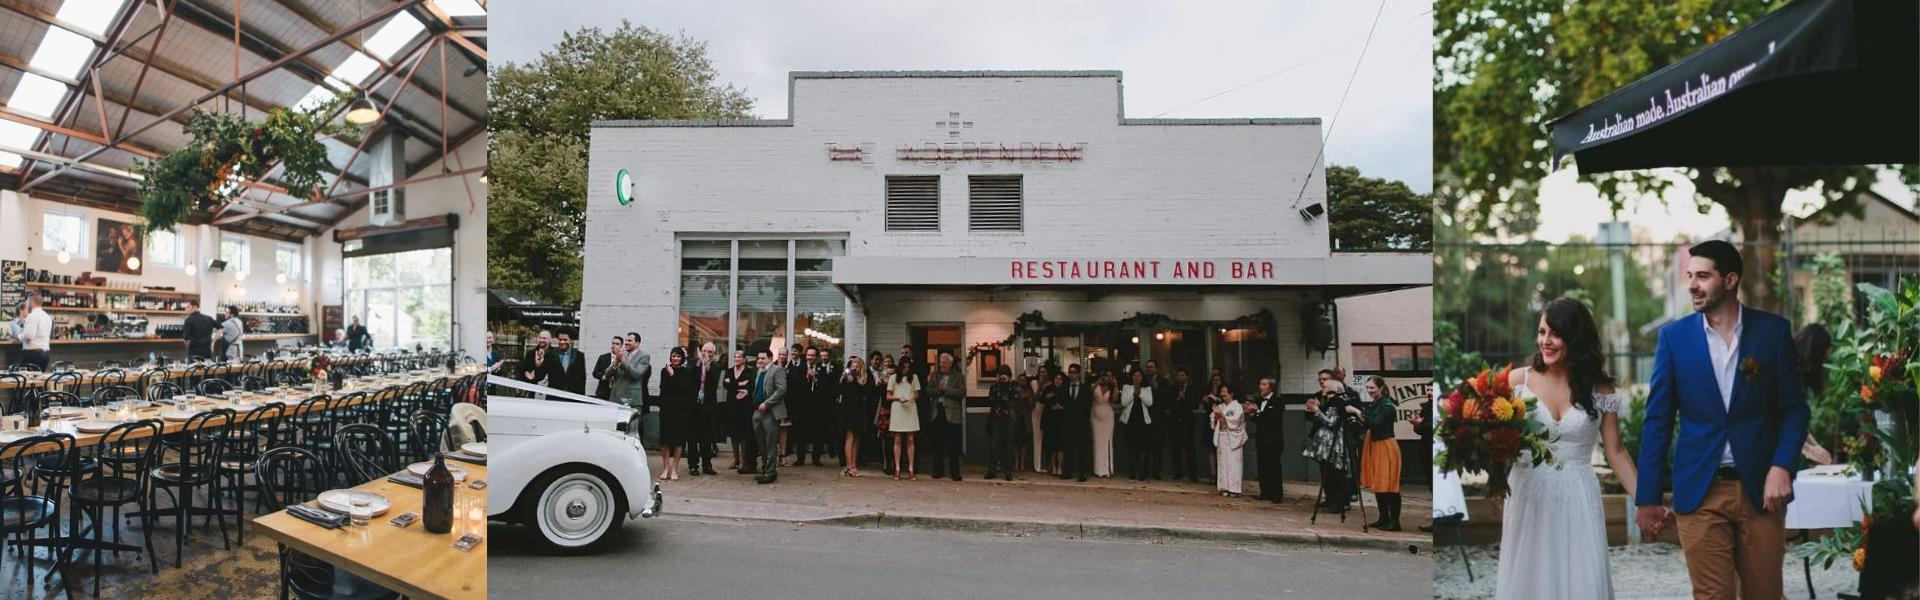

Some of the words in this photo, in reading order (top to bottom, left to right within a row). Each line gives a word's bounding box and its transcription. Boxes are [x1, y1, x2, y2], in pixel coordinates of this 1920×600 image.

[1580, 112, 1635, 144] Australian
[1664, 73, 1726, 117] Australian
[824, 142, 875, 165] THE
[895, 141, 1088, 165] INDEPENDENT
[1011, 261, 1162, 279] RESTAURANT
[1173, 261, 1215, 279] AND
[1232, 261, 1275, 279] BAR
